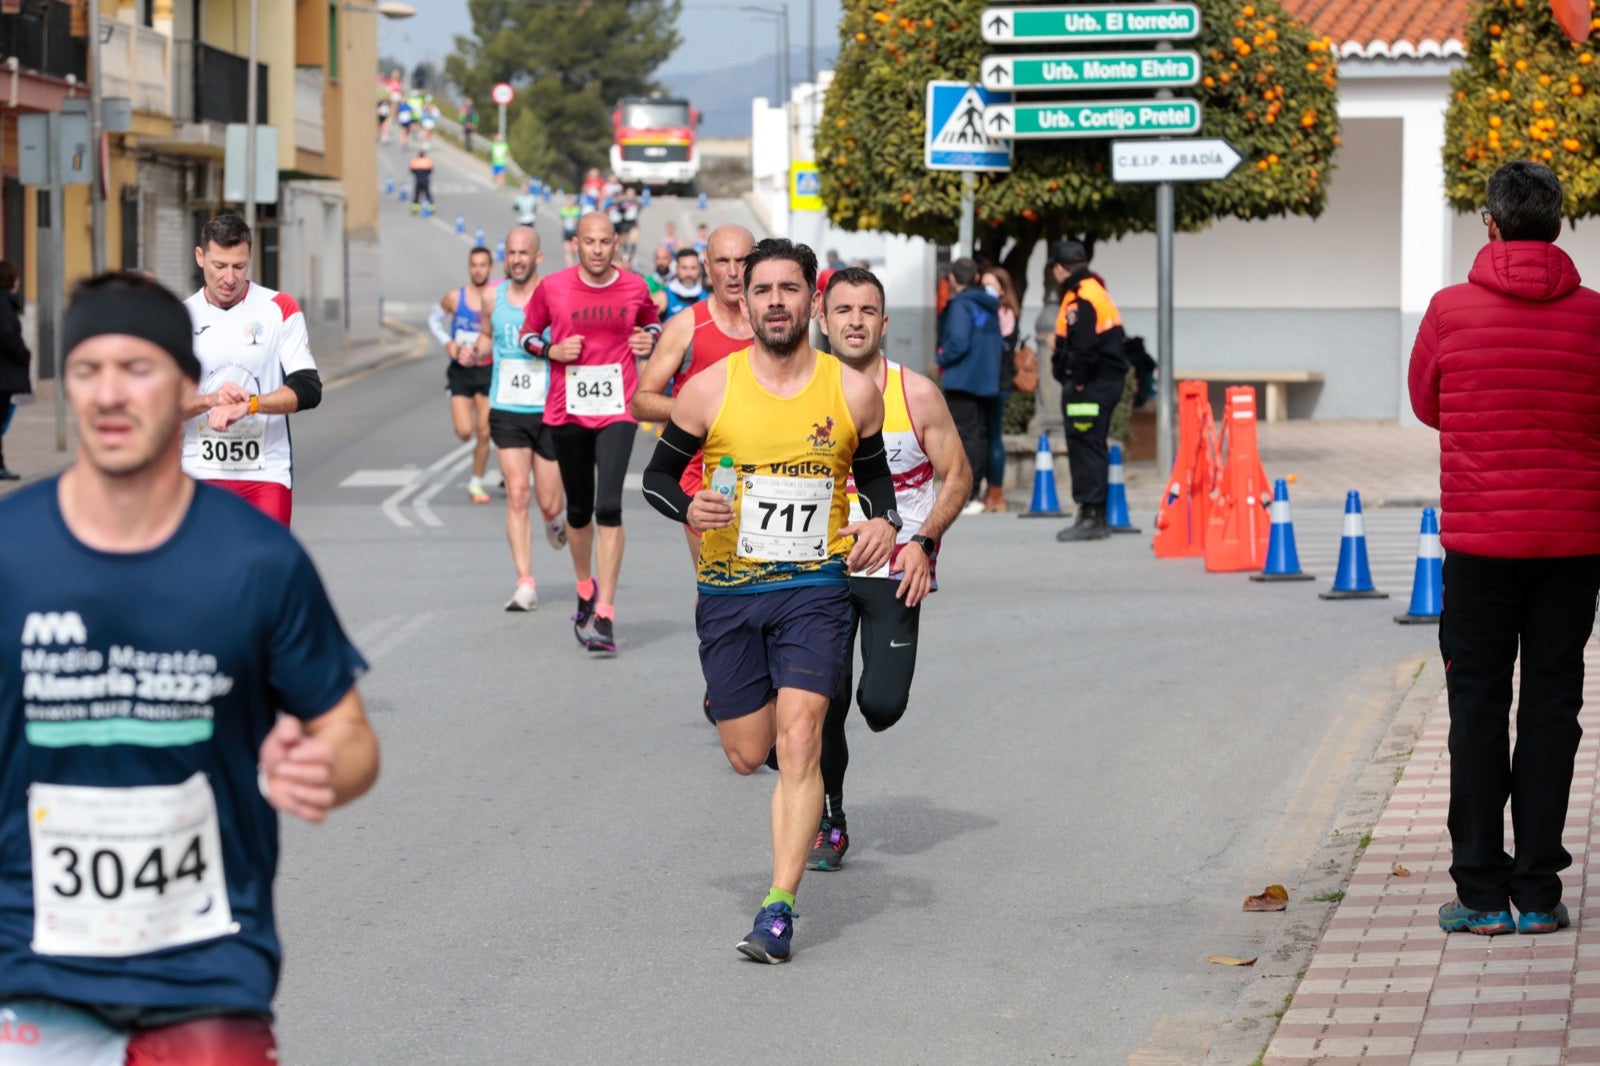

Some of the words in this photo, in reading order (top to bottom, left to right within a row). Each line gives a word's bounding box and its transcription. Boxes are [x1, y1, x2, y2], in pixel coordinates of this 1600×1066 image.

[1065, 13, 1101, 31] Urb.
[1106, 13, 1123, 30] El
[1127, 11, 1189, 30] torreón
[1042, 62, 1079, 80] Urb.
[1083, 61, 1137, 79] Monte
[1141, 59, 1189, 78] Elvira
[1038, 110, 1075, 128] Urb.
[1078, 108, 1136, 129] Cortijo
[1139, 106, 1190, 125] Pretel
[1170, 151, 1223, 165] ABADÍA
[511, 374, 531, 389] 48
[577, 381, 613, 397] 843
[202, 440, 260, 461] 3050
[758, 501, 818, 532] 717
[21, 647, 103, 673] Medio
[108, 644, 218, 674] Maratón
[23, 667, 136, 701] Almería
[136, 671, 213, 703] 2022
[50, 834, 207, 900] 3044
